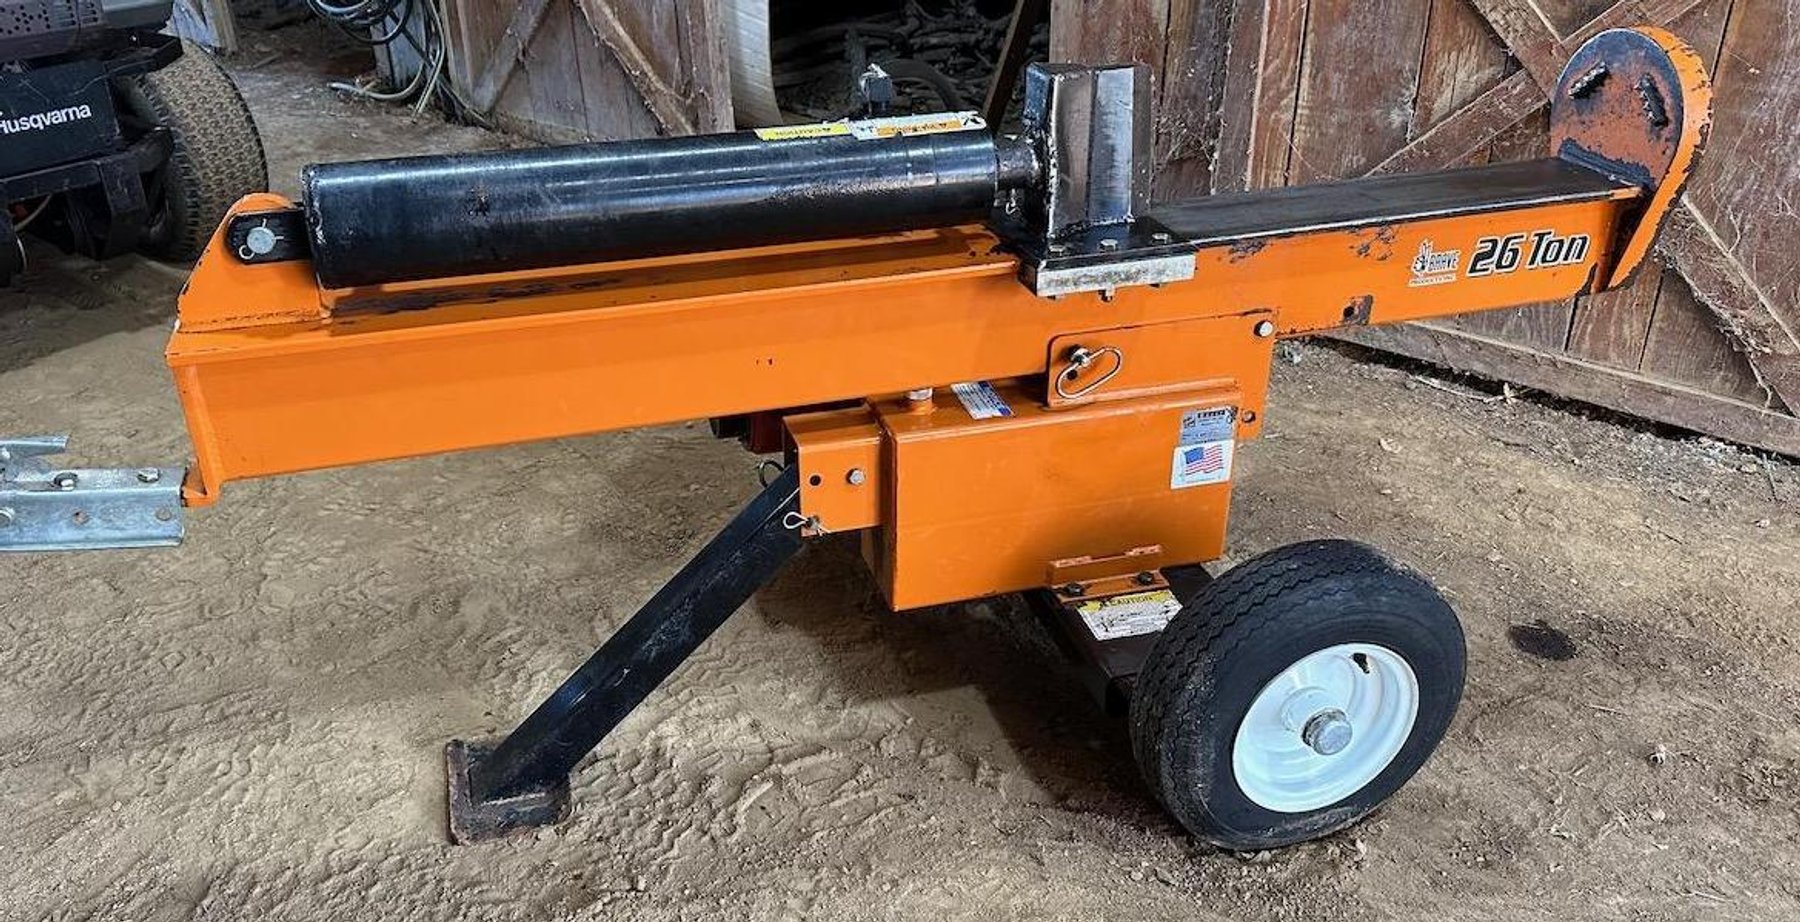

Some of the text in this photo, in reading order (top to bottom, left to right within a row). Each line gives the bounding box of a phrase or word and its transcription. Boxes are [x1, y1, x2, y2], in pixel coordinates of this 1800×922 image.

[1428, 250, 1460, 272] BRAVE
[1467, 229, 1588, 276] 26 Ton
